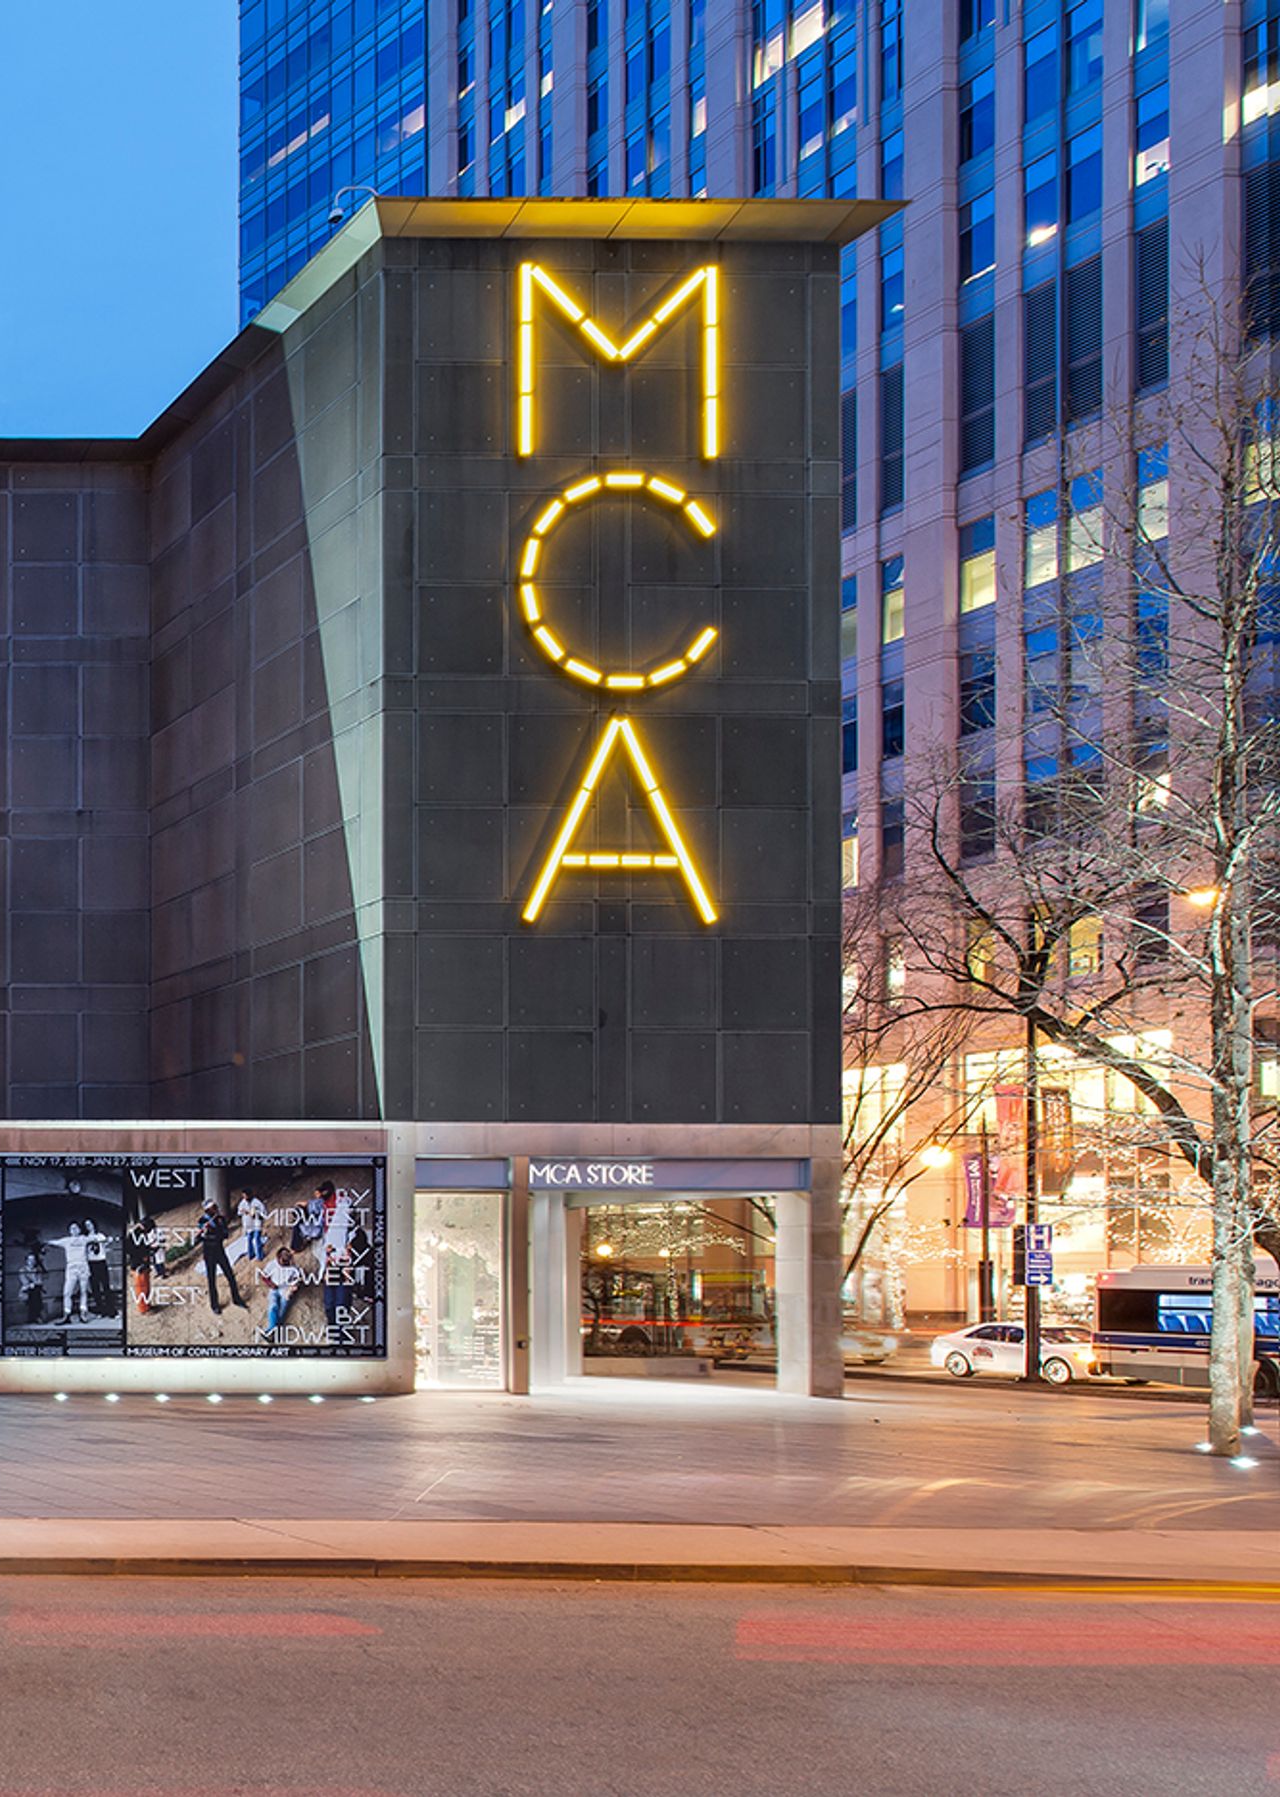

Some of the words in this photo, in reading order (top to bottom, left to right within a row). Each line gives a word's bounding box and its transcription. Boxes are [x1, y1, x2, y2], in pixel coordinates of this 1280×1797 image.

[518, 260, 719, 925] MCA
[23, 1157, 47, 1167] NOV
[201, 1157, 232, 1167] WEST
[234, 1157, 251, 1167] BY
[252, 1157, 304, 1167] MIDWEST
[130, 1168, 201, 1188] WEST
[528, 1164, 582, 1185] MCA
[587, 1164, 654, 1185] STORE
[335, 1188, 371, 1207] BY
[254, 1207, 370, 1227] MIDWEST
[129, 1226, 200, 1246] WEST
[374, 1215, 384, 1243] MADE
[1028, 1225, 1051, 1251] H
[335, 1248, 371, 1266] BY
[374, 1245, 384, 1267] YOU
[254, 1266, 370, 1287] MIDWEST
[374, 1269, 384, 1298] LOOK
[130, 1285, 201, 1305] WEST
[335, 1305, 371, 1325] BY
[254, 1325, 370, 1345] MIDWEST
[127, 1347, 170, 1357] MUSEUM
[172, 1347, 187, 1357] OF
[189, 1347, 269, 1357] CONTEMPORARY
[271, 1347, 291, 1357] ART
